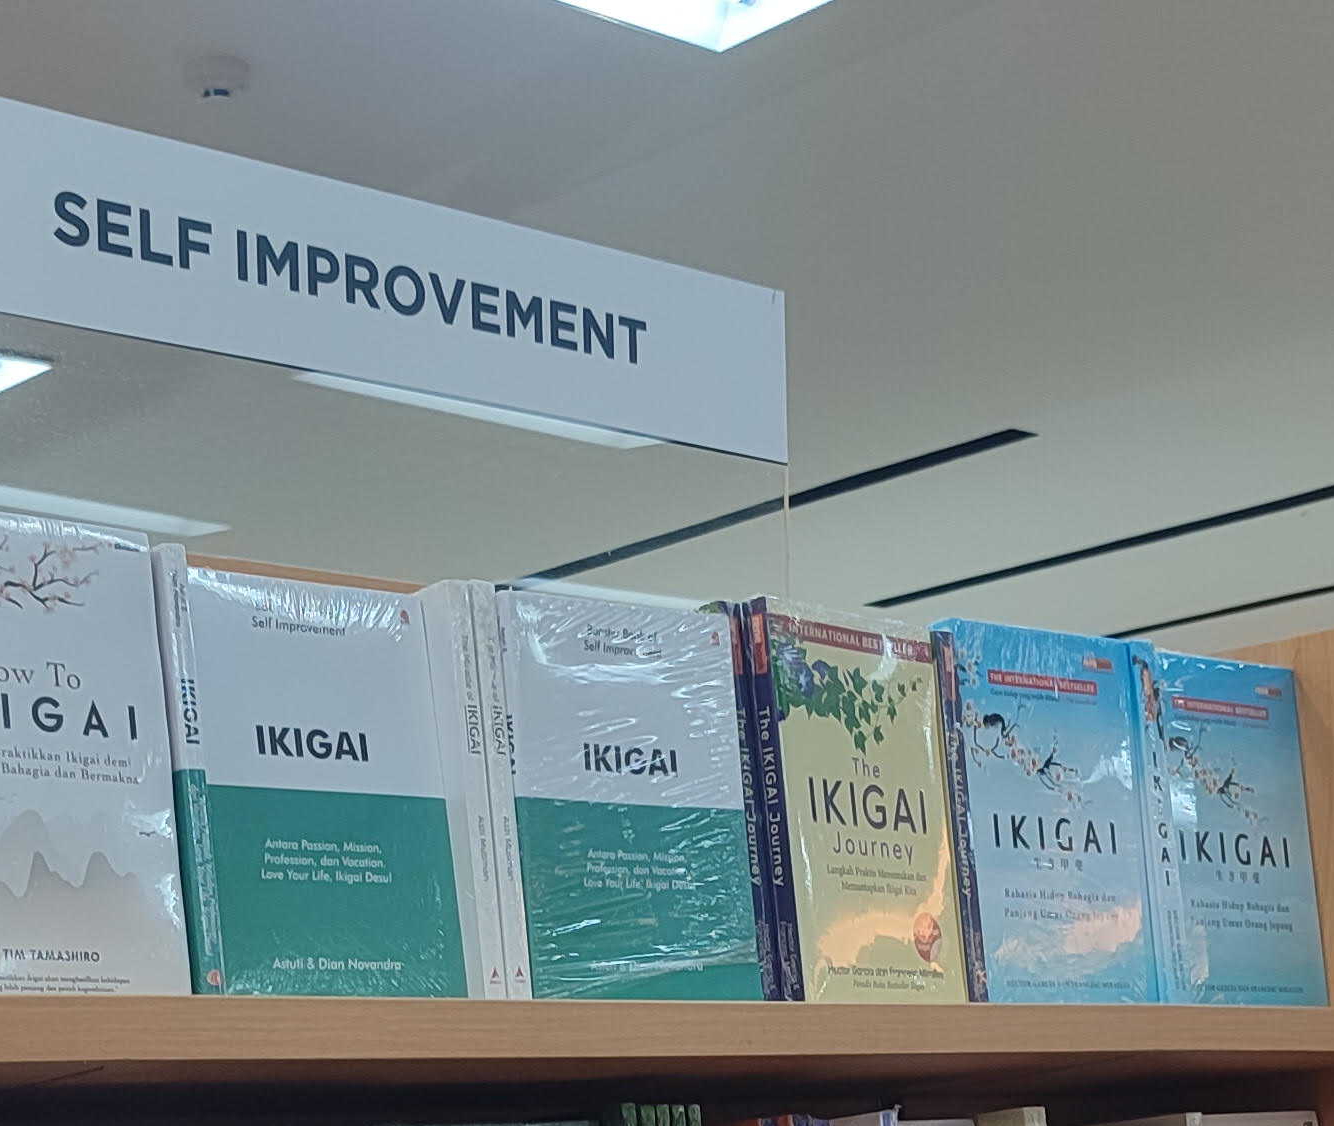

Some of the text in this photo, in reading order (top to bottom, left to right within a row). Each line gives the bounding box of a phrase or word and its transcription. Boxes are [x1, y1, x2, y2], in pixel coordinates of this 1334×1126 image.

[53, 191, 647, 364] SELF IMPROVEMENT
[251, 615, 272, 630] Self
[46, 661, 81, 690] To
[66, 751, 101, 767] Ikigai
[104, 755, 132, 769] demi
[255, 724, 370, 763] IKIGAI
[582, 742, 679, 778] IKIGAI
[1, 762, 51, 780] Bahagia
[54, 768, 77, 780] dan
[81, 769, 140, 786] Bermakna
[851, 756, 881, 779] The
[762, 746, 786, 888] IKIGAI Journey
[808, 776, 928, 835] IKIGAI
[832, 831, 915, 866] Journey
[992, 812, 1117, 856] IKIGAI
[1177, 829, 1291, 869] IKIGAI
[29, 949, 101, 963] TAMASHIRO
[348, 958, 403, 971] Novandra
